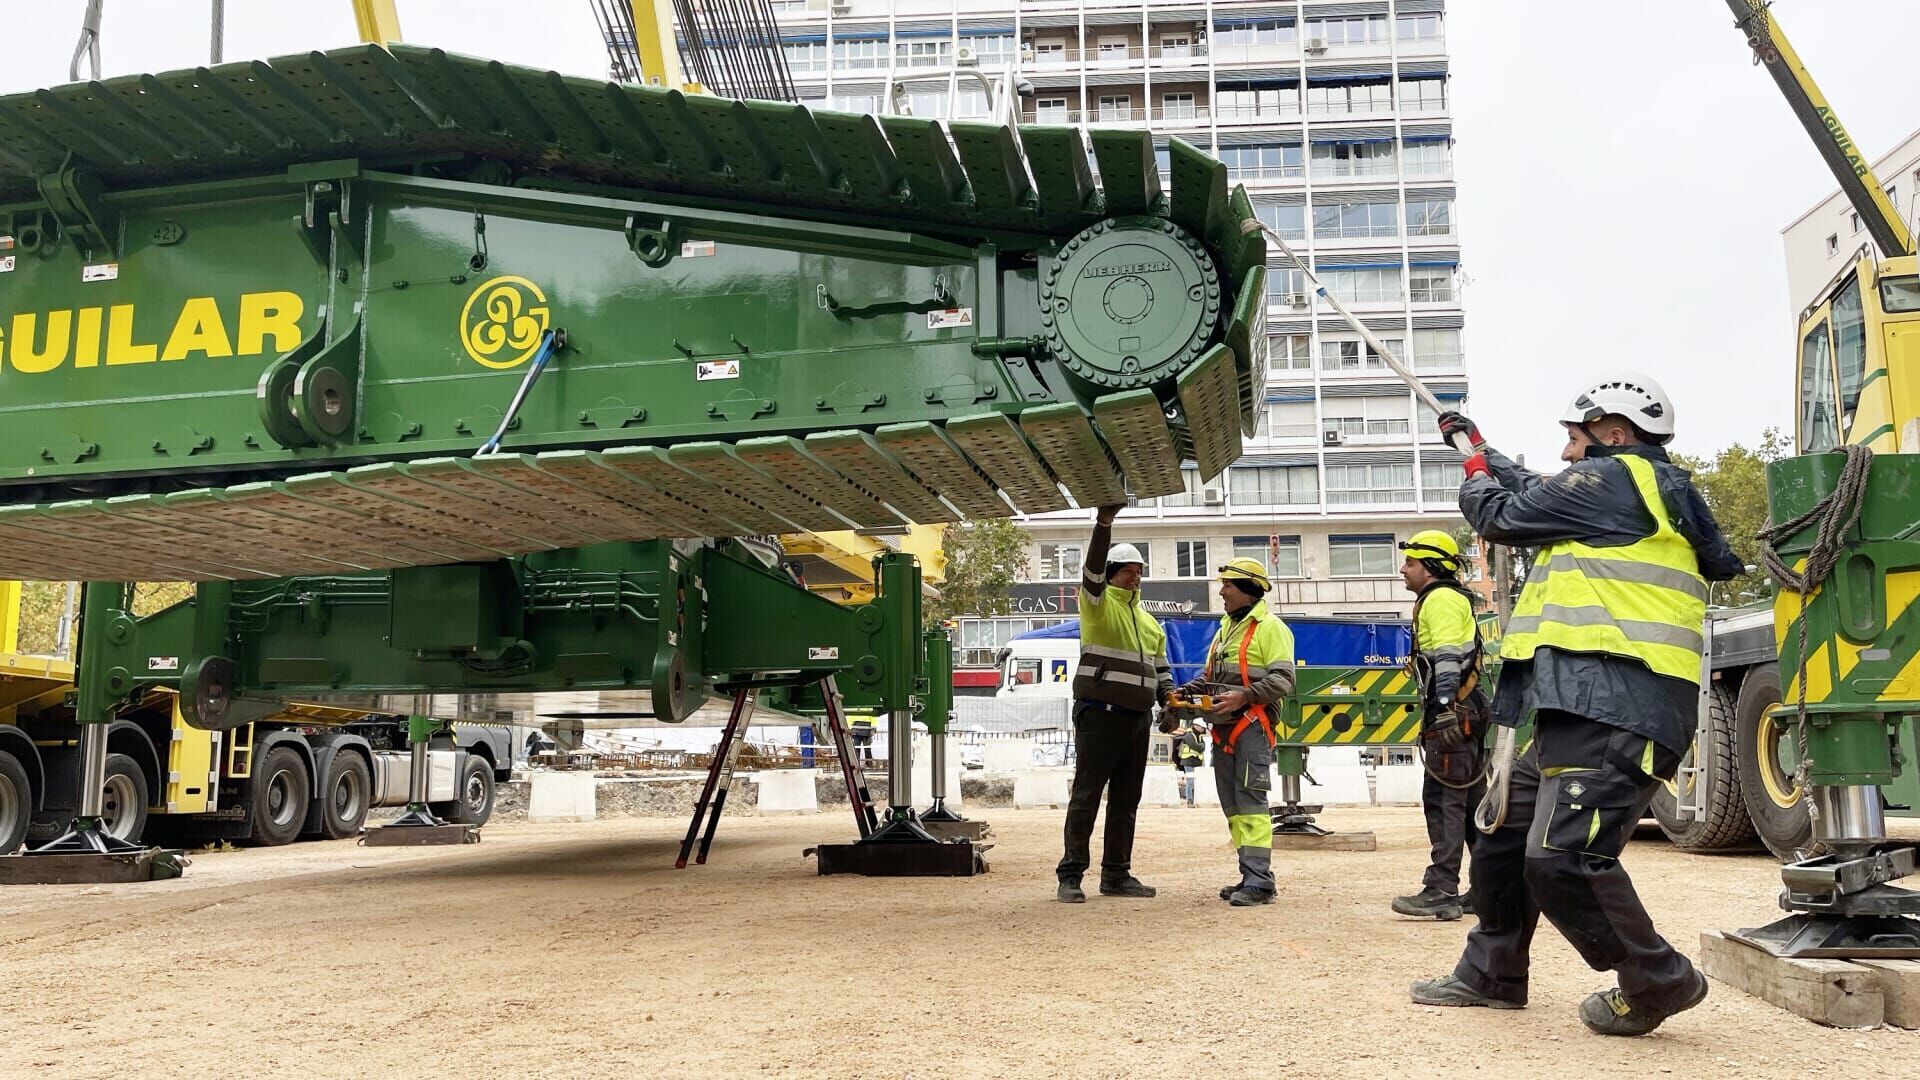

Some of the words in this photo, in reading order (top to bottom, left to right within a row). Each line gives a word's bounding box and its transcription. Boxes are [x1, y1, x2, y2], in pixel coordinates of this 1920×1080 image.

[1816, 106, 1868, 178] AGUILAR
[1083, 261, 1171, 278] LIEBHERR
[0, 291, 304, 374] UILAR
